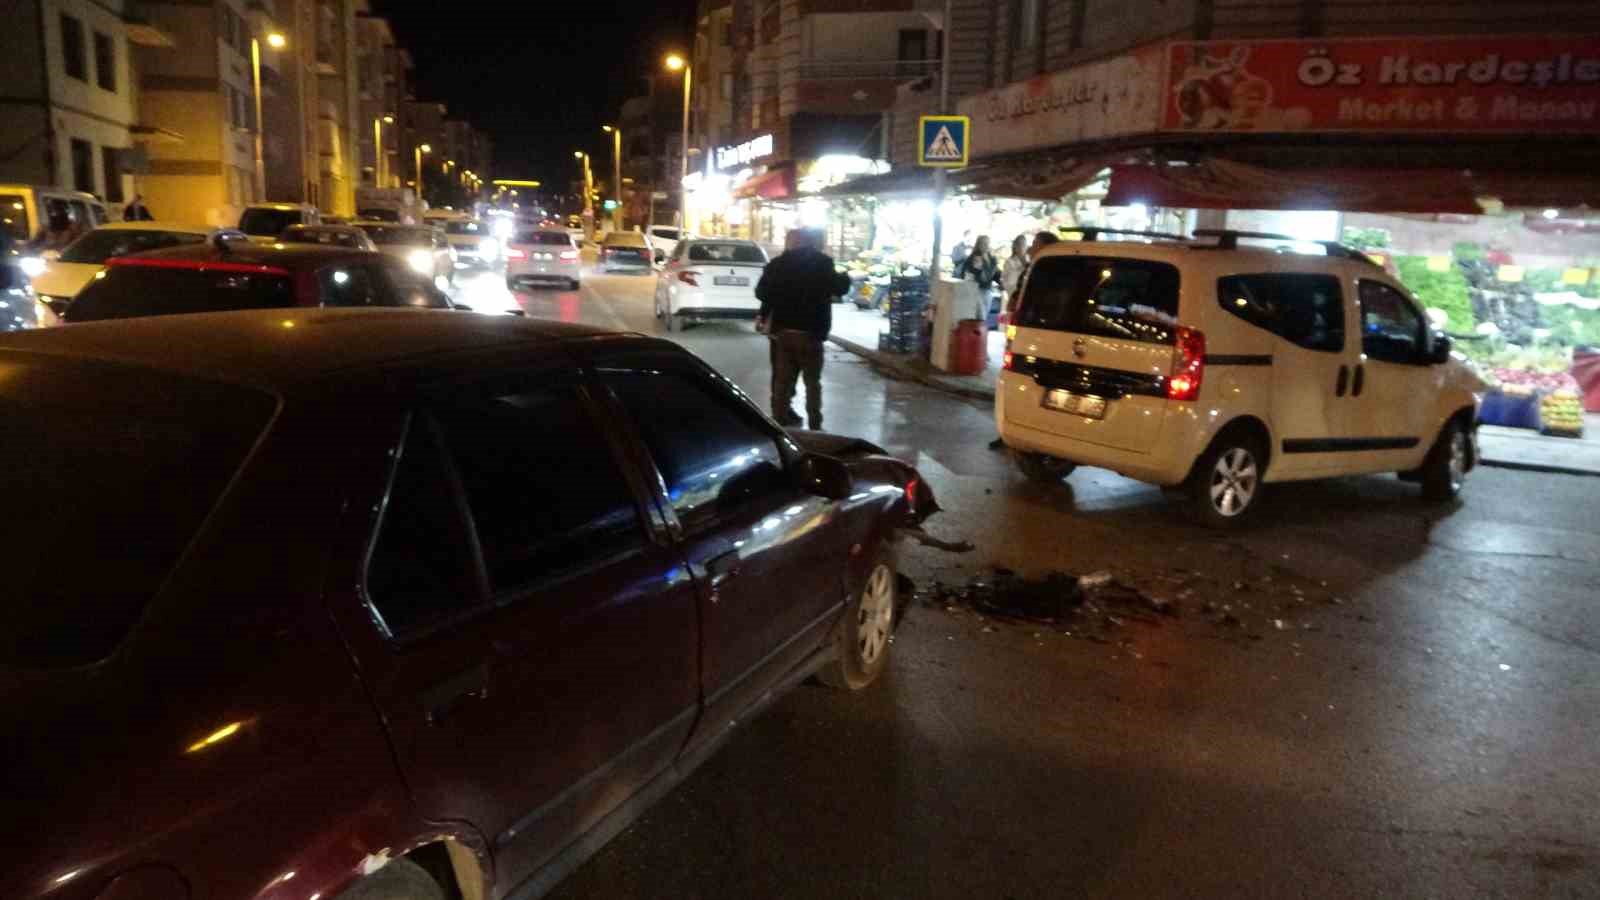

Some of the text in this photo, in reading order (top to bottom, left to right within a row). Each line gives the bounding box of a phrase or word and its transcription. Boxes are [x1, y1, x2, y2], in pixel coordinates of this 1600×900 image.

[1297, 48, 1363, 86] Öz
[1337, 96, 1596, 121] Market & Manav
